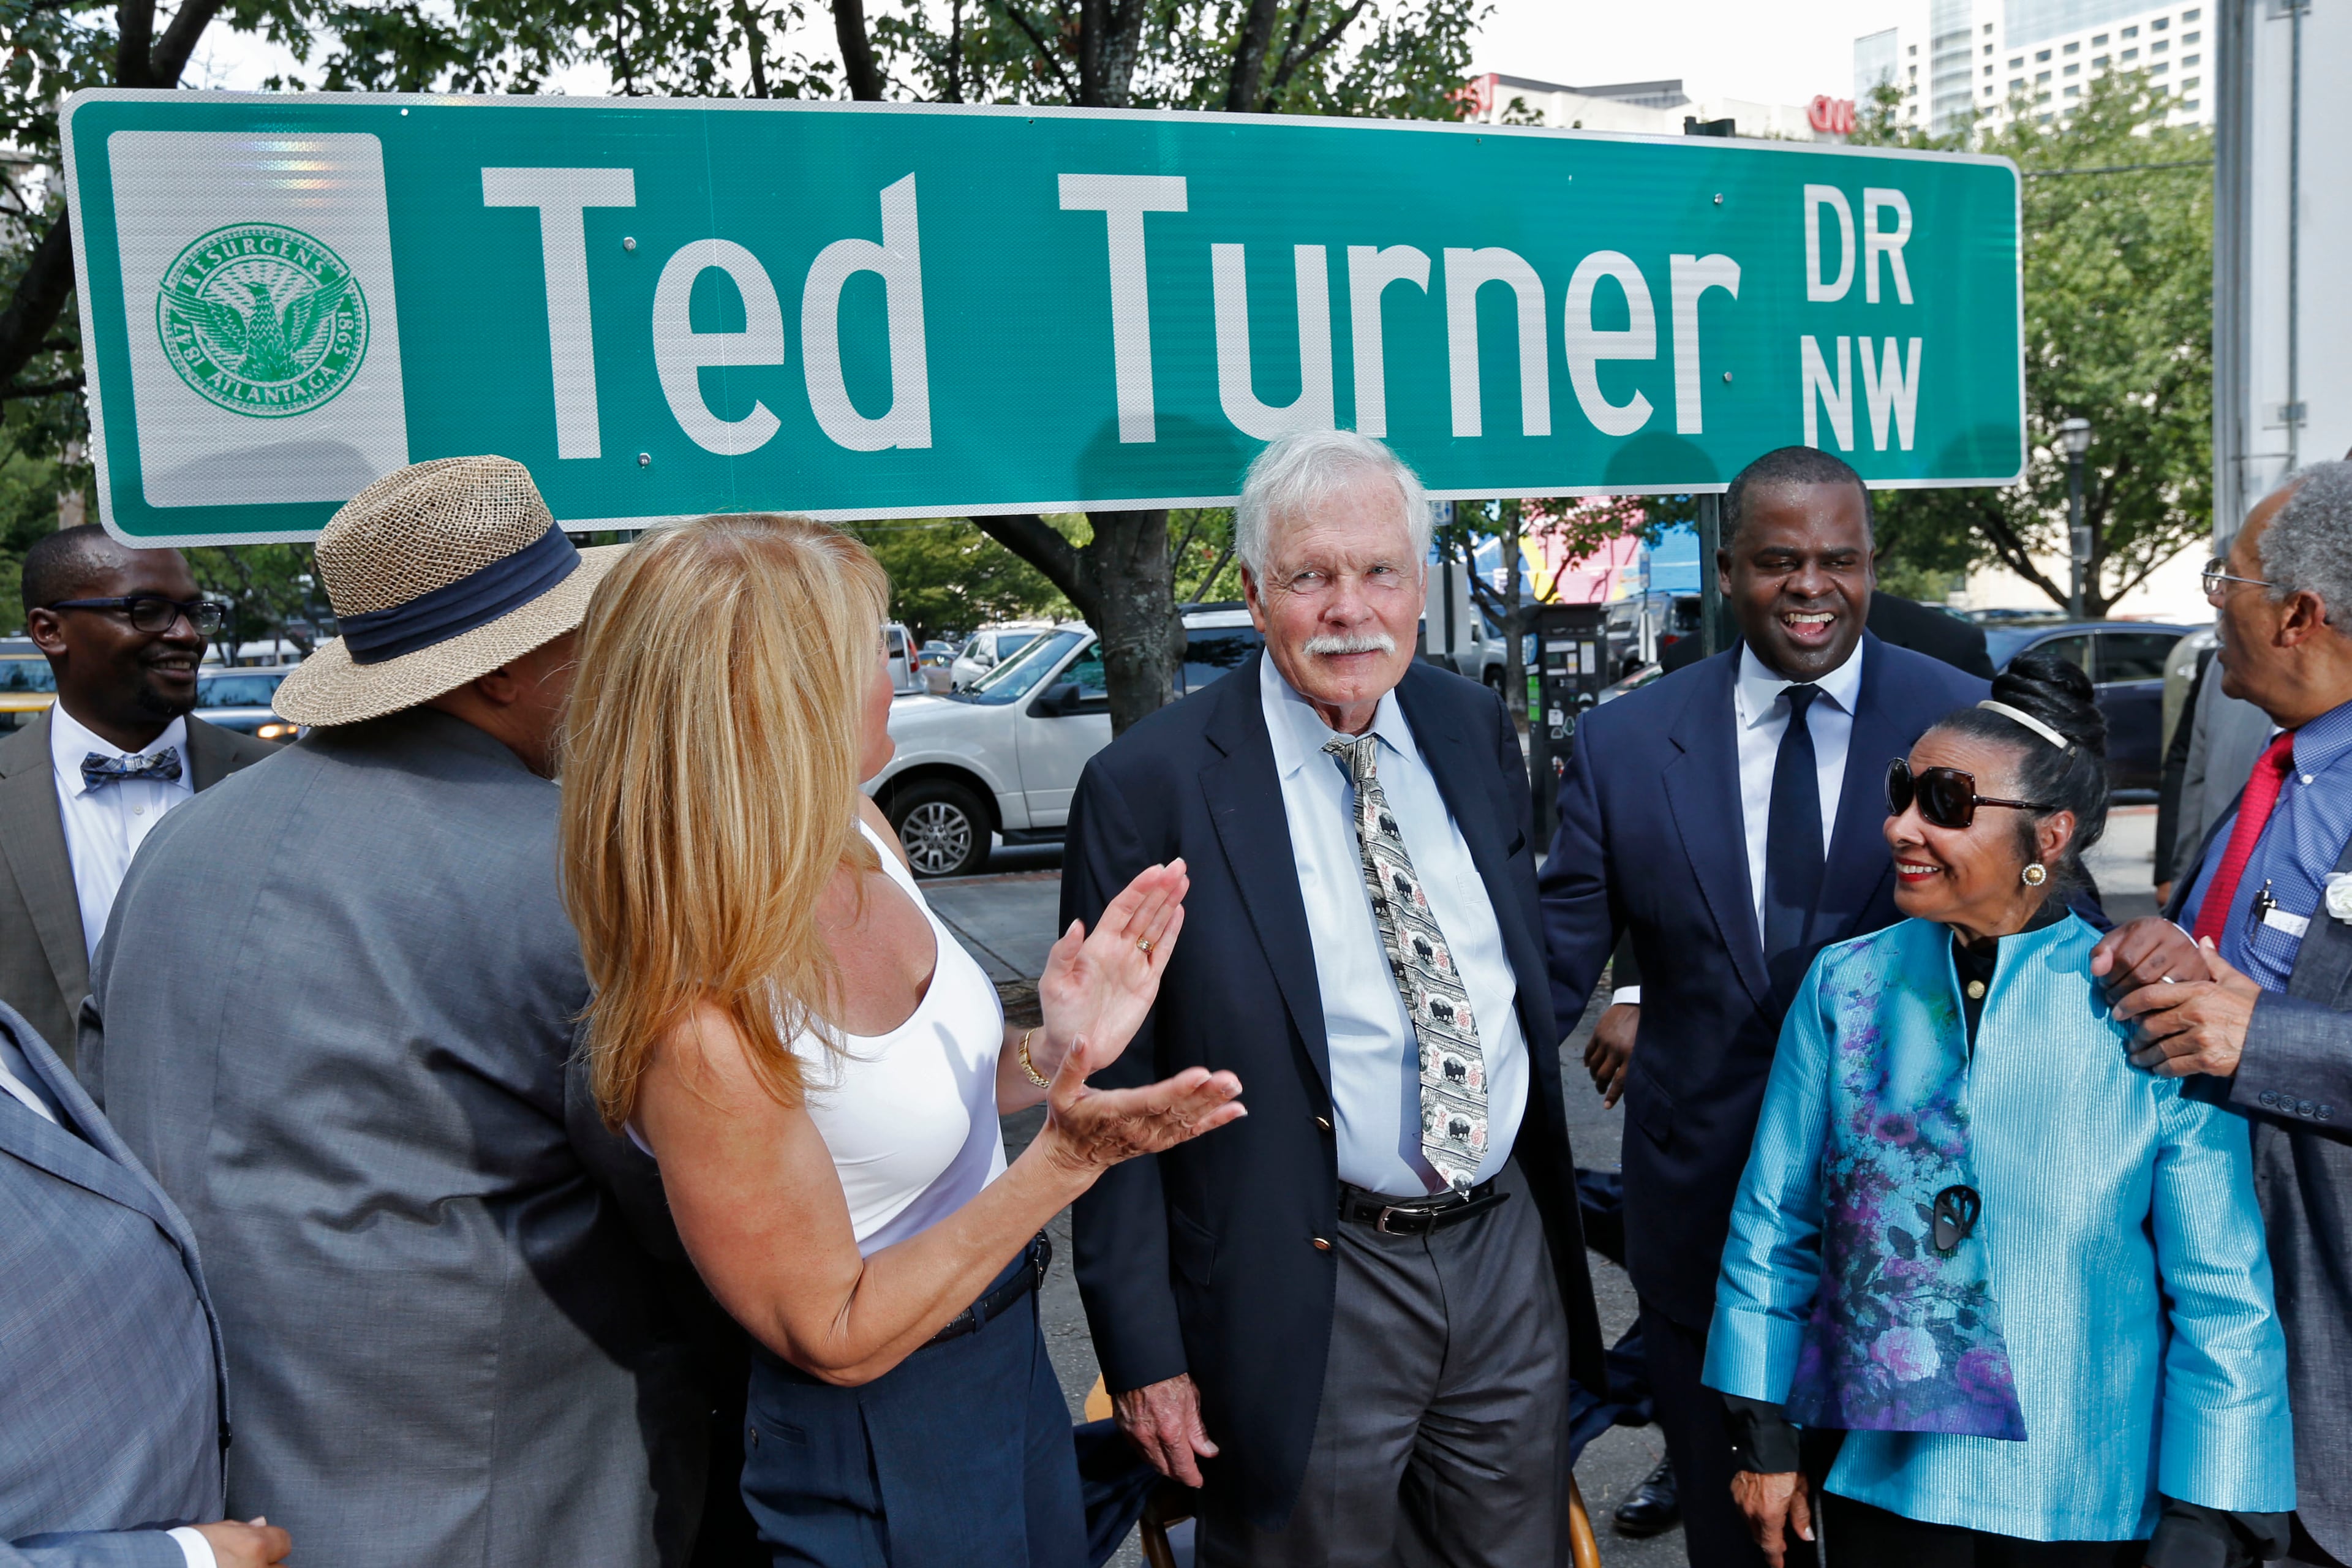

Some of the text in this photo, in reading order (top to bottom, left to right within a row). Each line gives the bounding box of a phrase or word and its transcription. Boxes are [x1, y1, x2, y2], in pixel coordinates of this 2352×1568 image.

[180, 237, 327, 289] RESURGENS
[1803, 184, 1914, 304] DR
[334, 311, 355, 357] 1865
[481, 167, 1741, 459] Ted Turner
[173, 317, 207, 368] 1847
[1800, 335, 1923, 451] NW
[1596, 624, 1605, 637] 5
